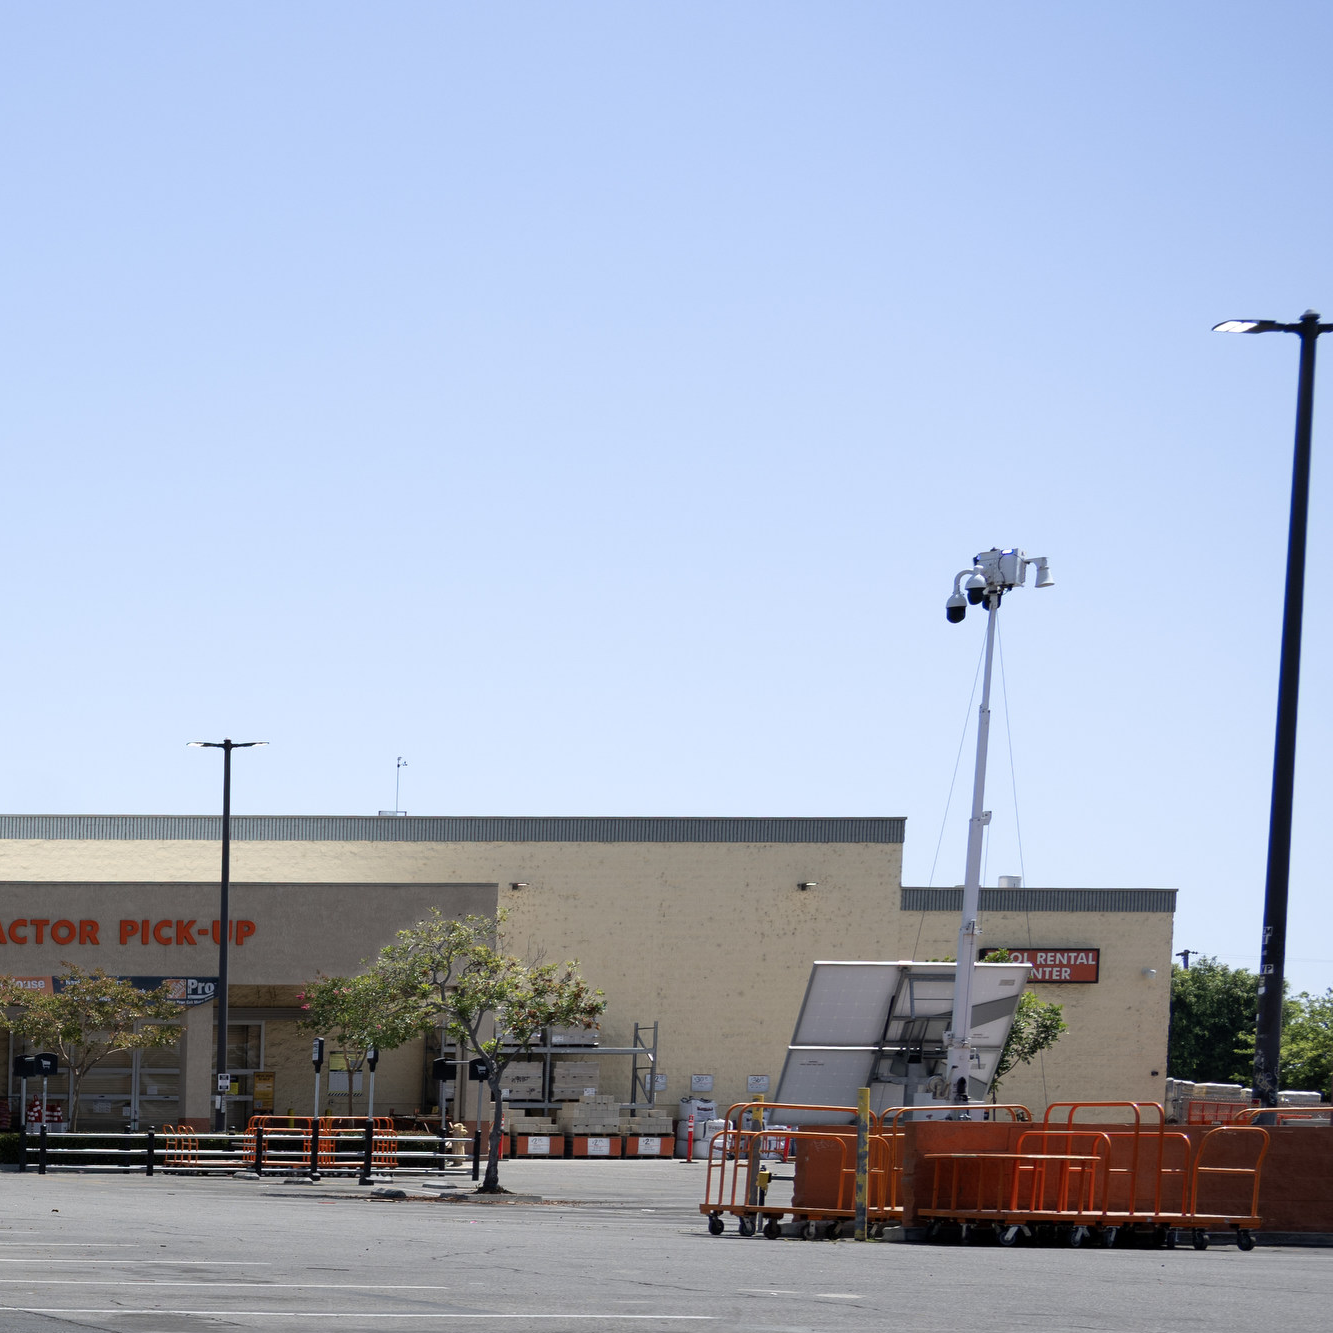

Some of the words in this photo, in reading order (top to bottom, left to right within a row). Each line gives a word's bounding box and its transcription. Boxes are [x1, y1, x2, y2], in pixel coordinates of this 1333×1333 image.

[119, 919, 256, 946] PICK-UP
[1036, 952, 1095, 964] RENTAL
[1030, 967, 1071, 979] NTER
[12, 978, 45, 989] ouse
[187, 979, 215, 994] Pro
